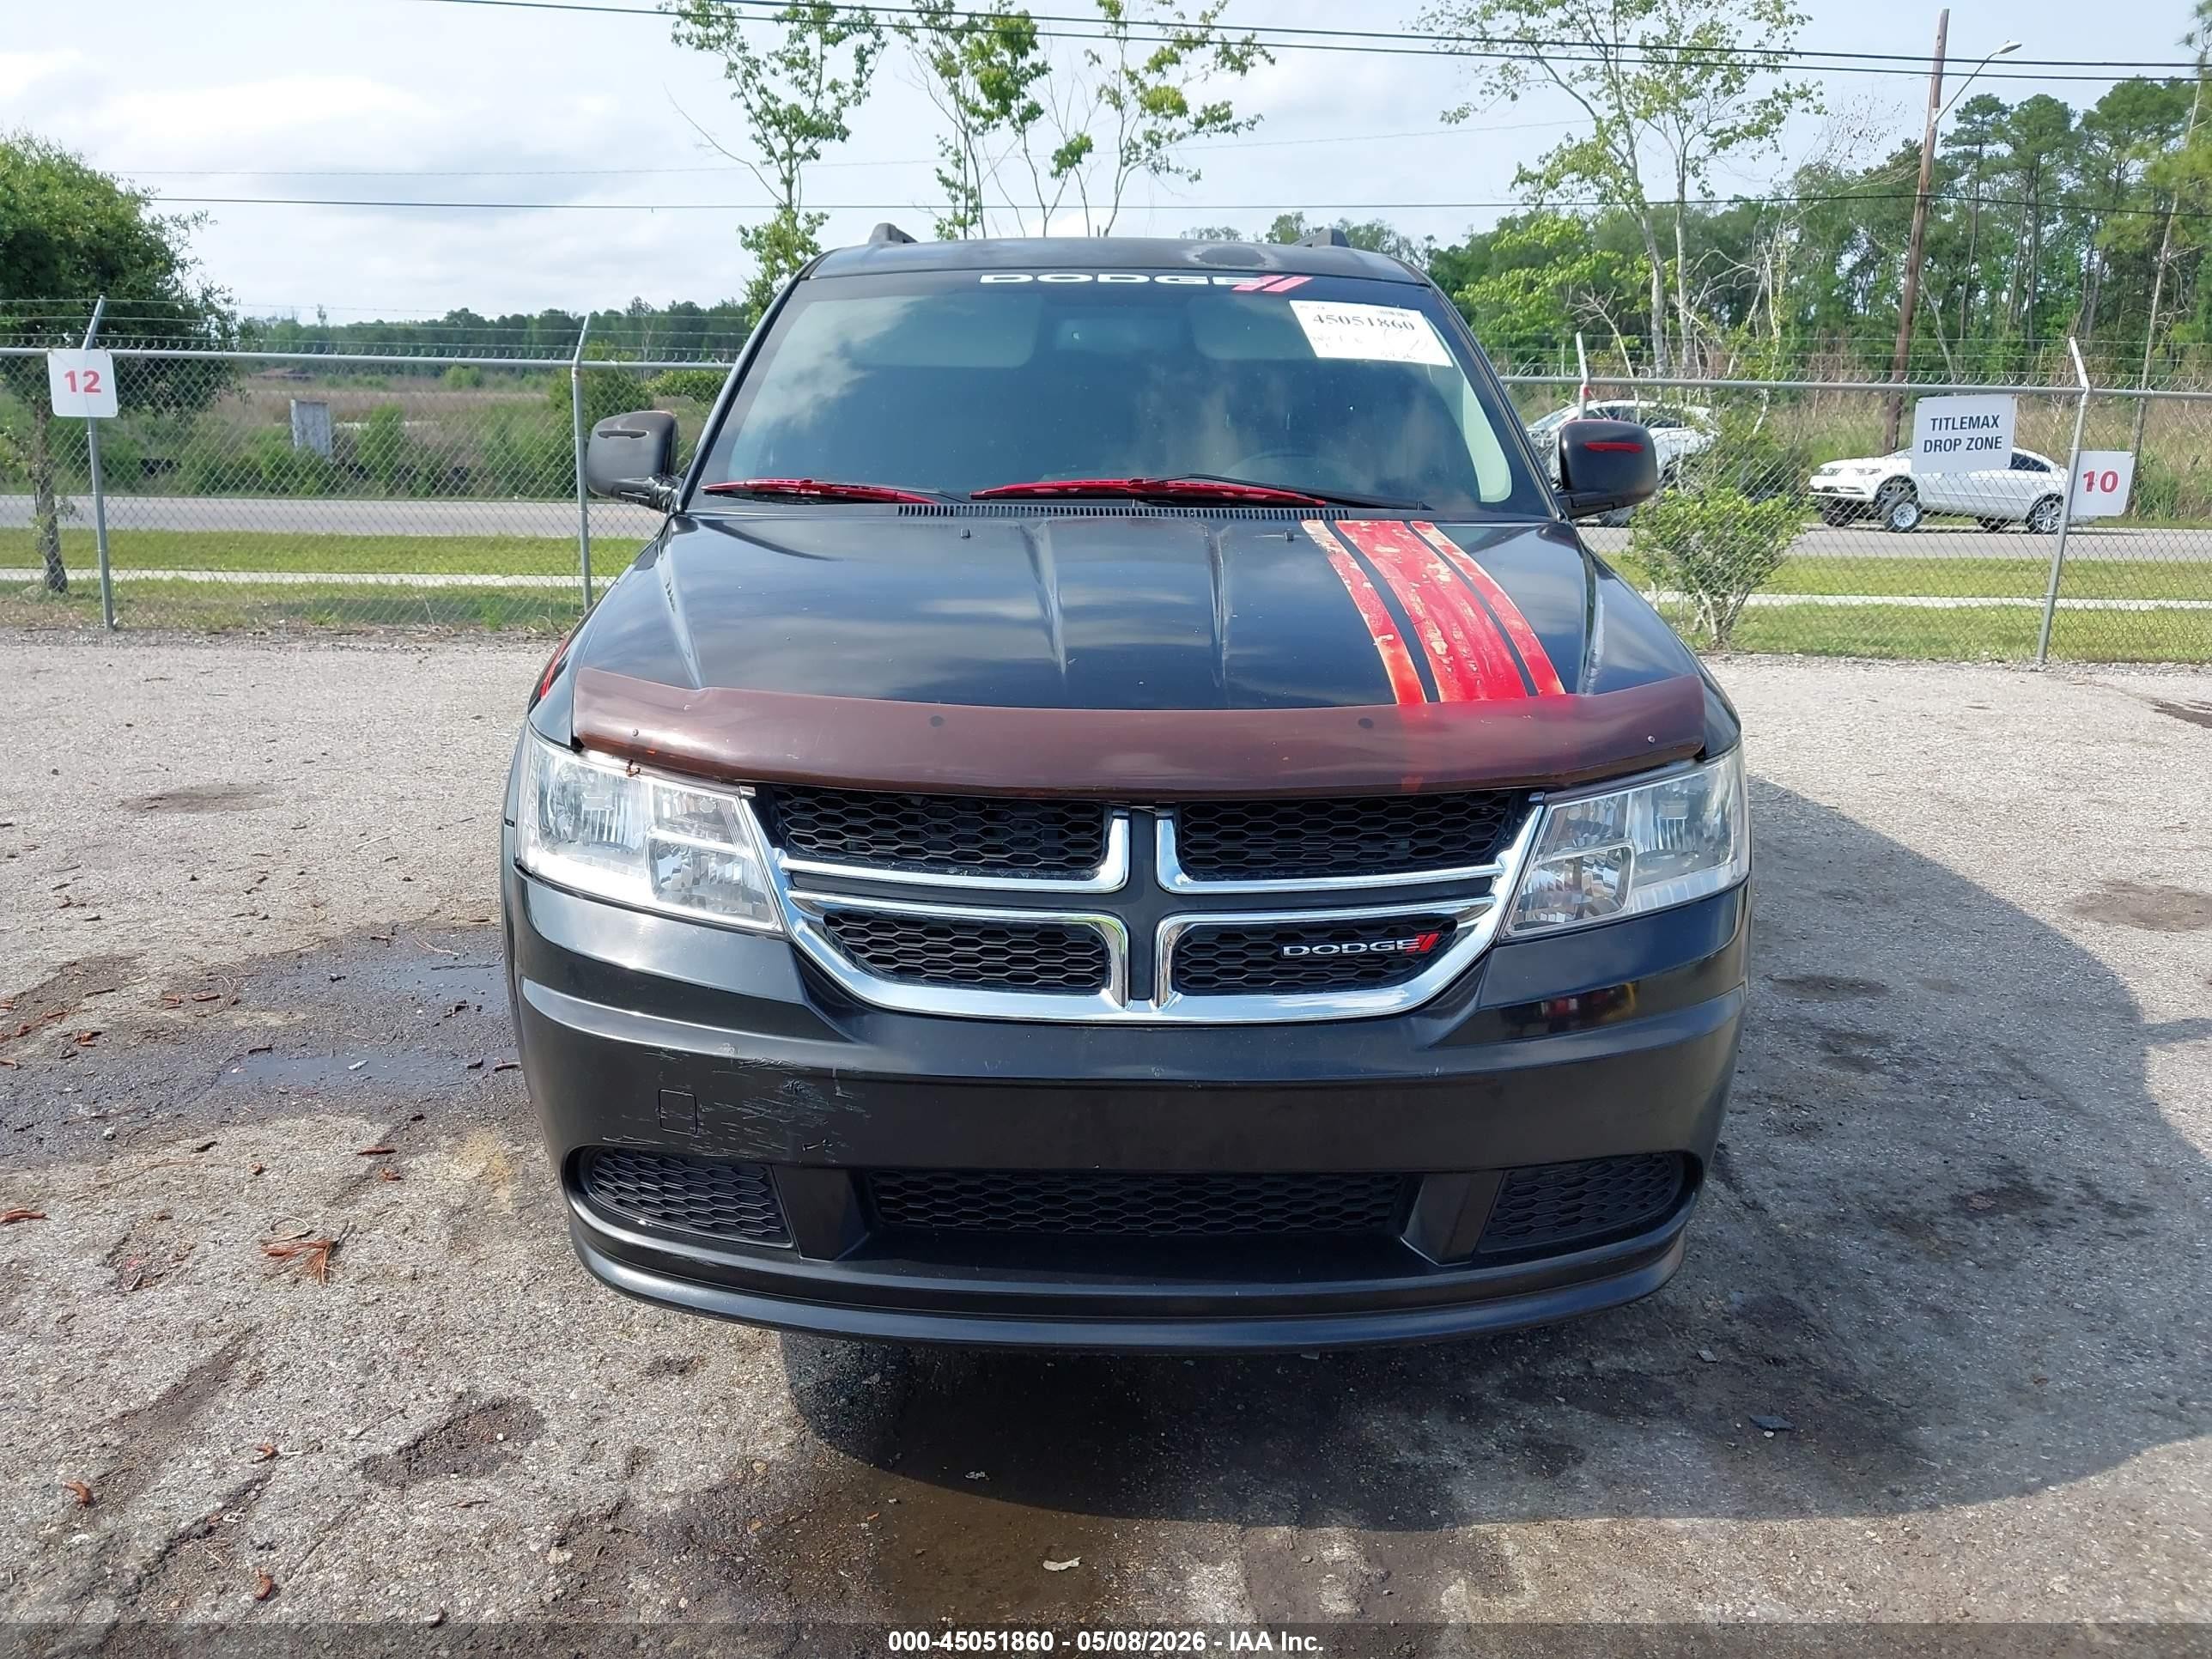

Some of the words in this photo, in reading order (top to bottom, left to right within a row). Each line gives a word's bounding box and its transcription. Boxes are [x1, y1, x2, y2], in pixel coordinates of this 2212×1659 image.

[980, 274, 1270, 285] DODGE
[1313, 313, 1415, 331] 45051860
[64, 370, 101, 392] 12
[1930, 415, 1999, 431] TITLEMAX
[1923, 438, 1961, 453] DROP
[1966, 436, 2002, 451] ZONE
[2083, 471, 2118, 493] 10
[1283, 939, 1419, 956] DODGE
